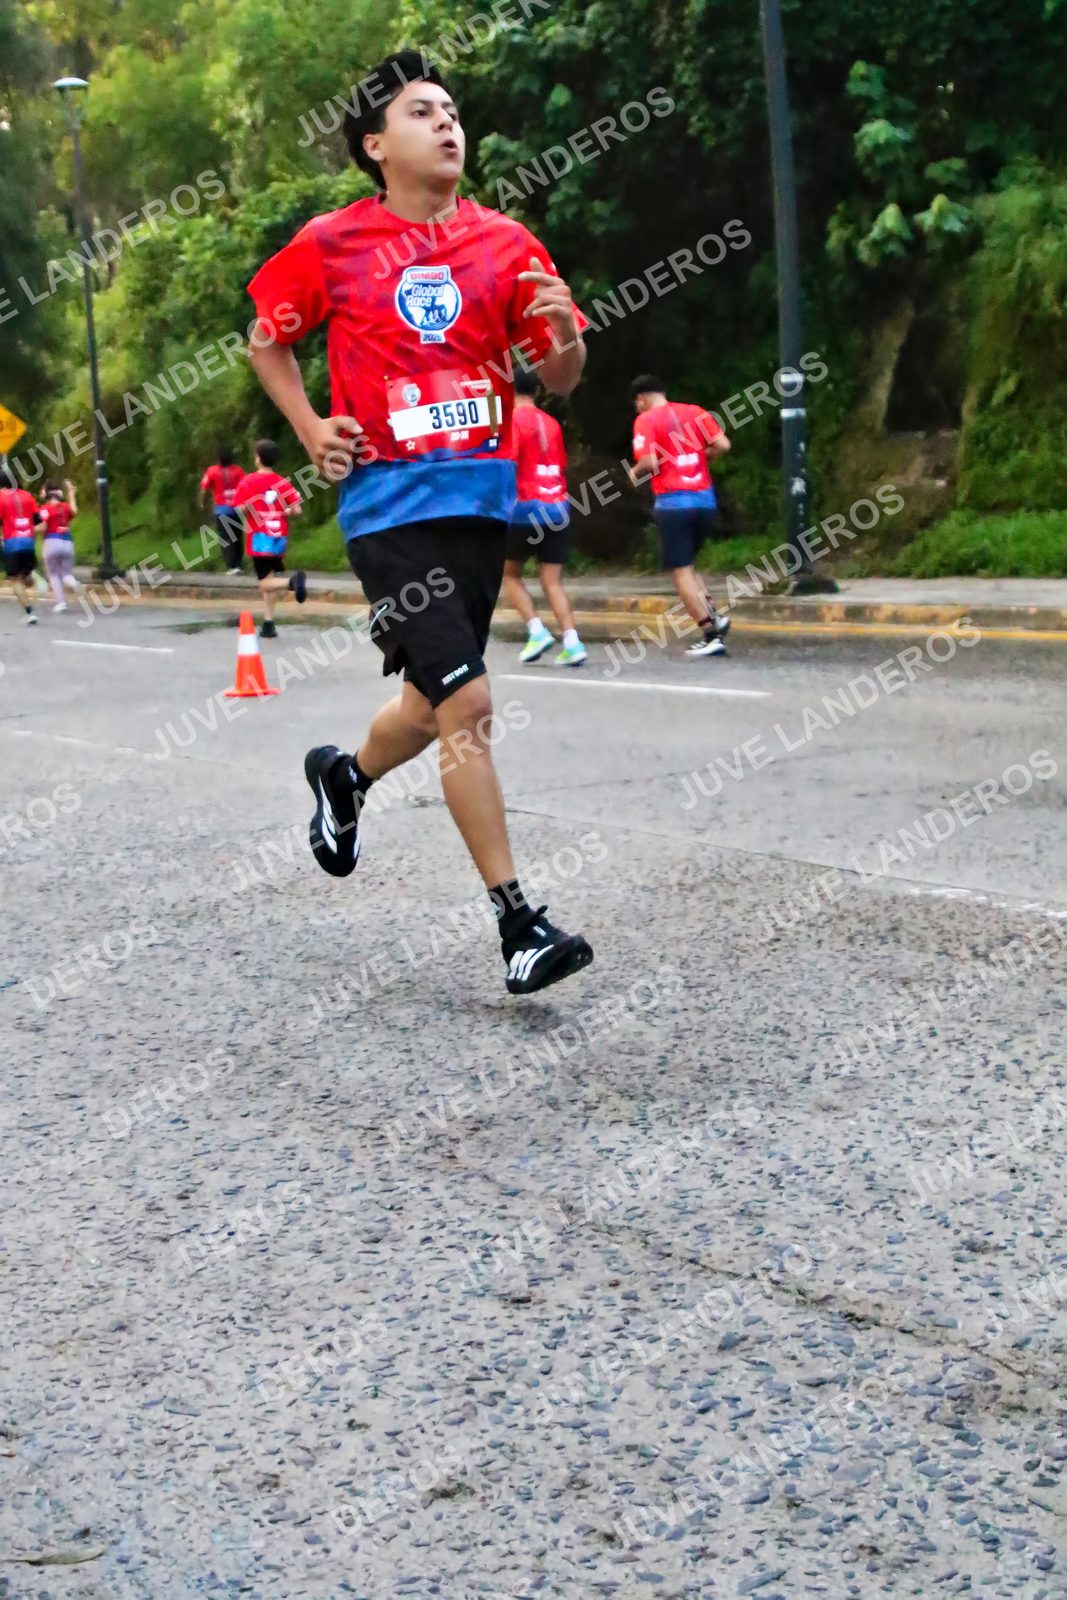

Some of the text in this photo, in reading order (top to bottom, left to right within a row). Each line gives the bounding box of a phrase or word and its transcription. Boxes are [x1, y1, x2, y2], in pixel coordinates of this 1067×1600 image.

[410, 272, 444, 280] BIMBO
[412, 285, 444, 296] Global
[406, 296, 432, 307] Race
[429, 400, 479, 429] 3590
